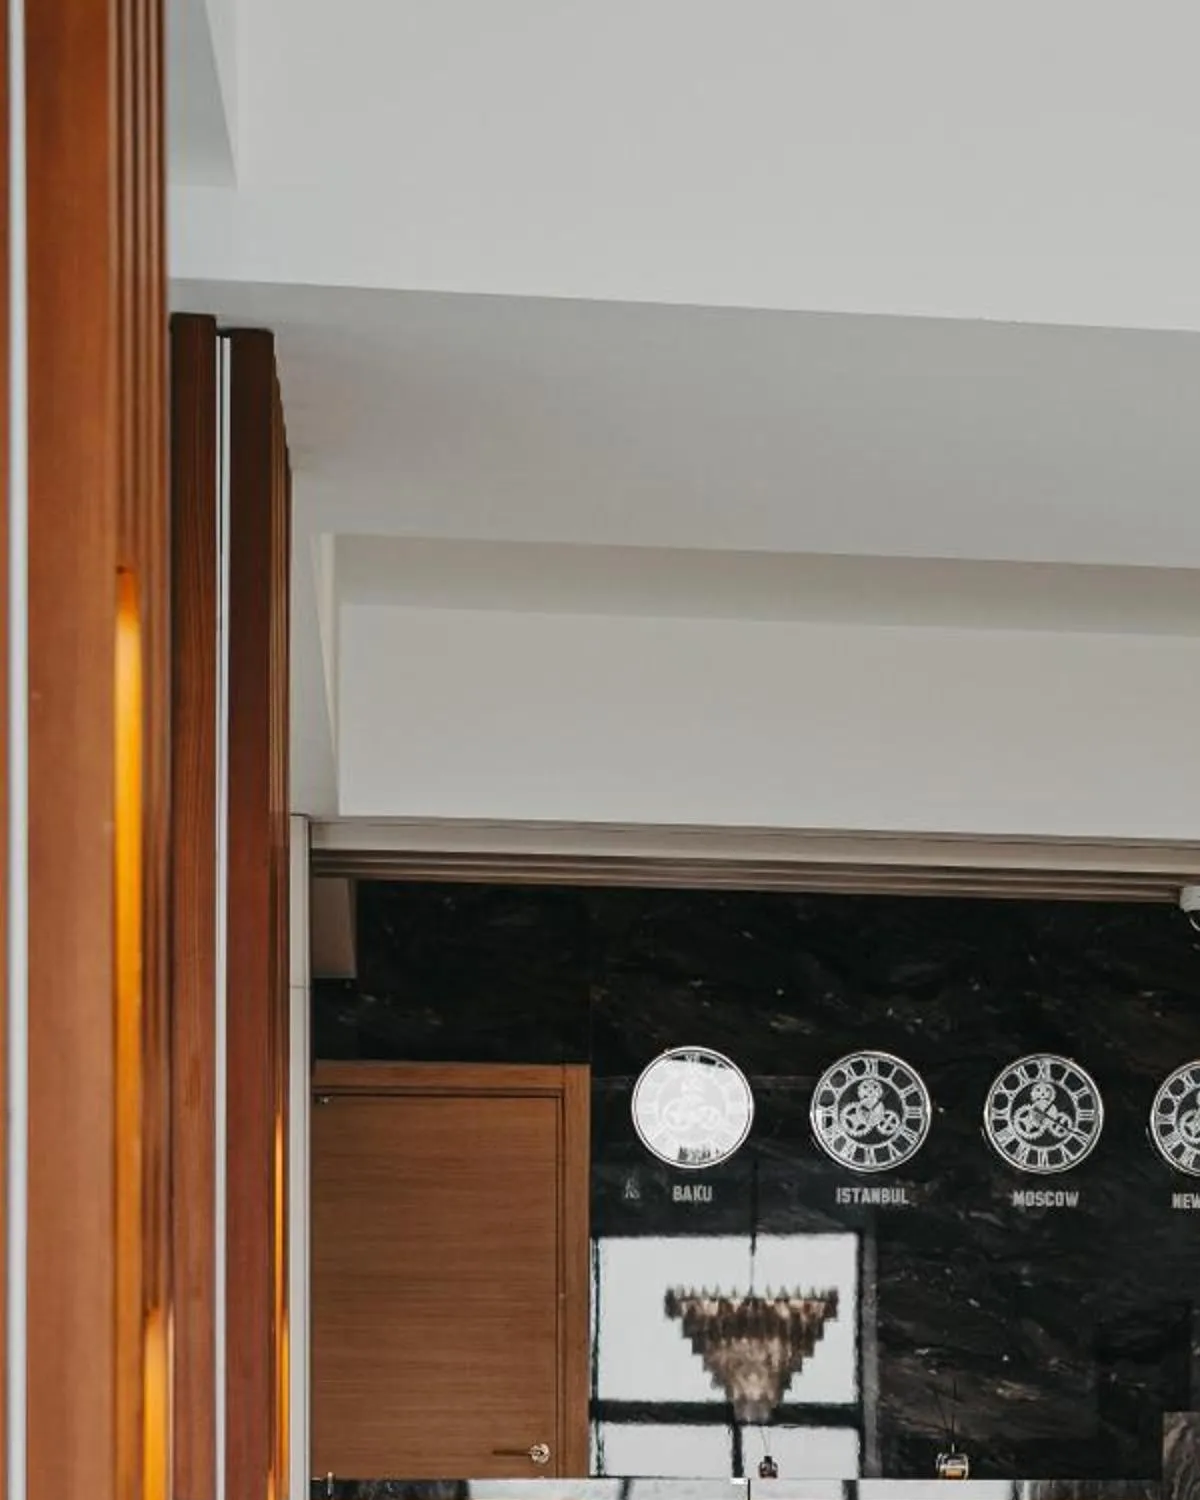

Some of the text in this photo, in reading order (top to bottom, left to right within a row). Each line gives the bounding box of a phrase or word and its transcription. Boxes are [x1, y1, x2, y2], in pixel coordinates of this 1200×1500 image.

[673, 1185, 713, 1202] BAKU
[836, 1186, 909, 1204] ISTANBUL
[1013, 1190, 1079, 1208] MOSCOW
